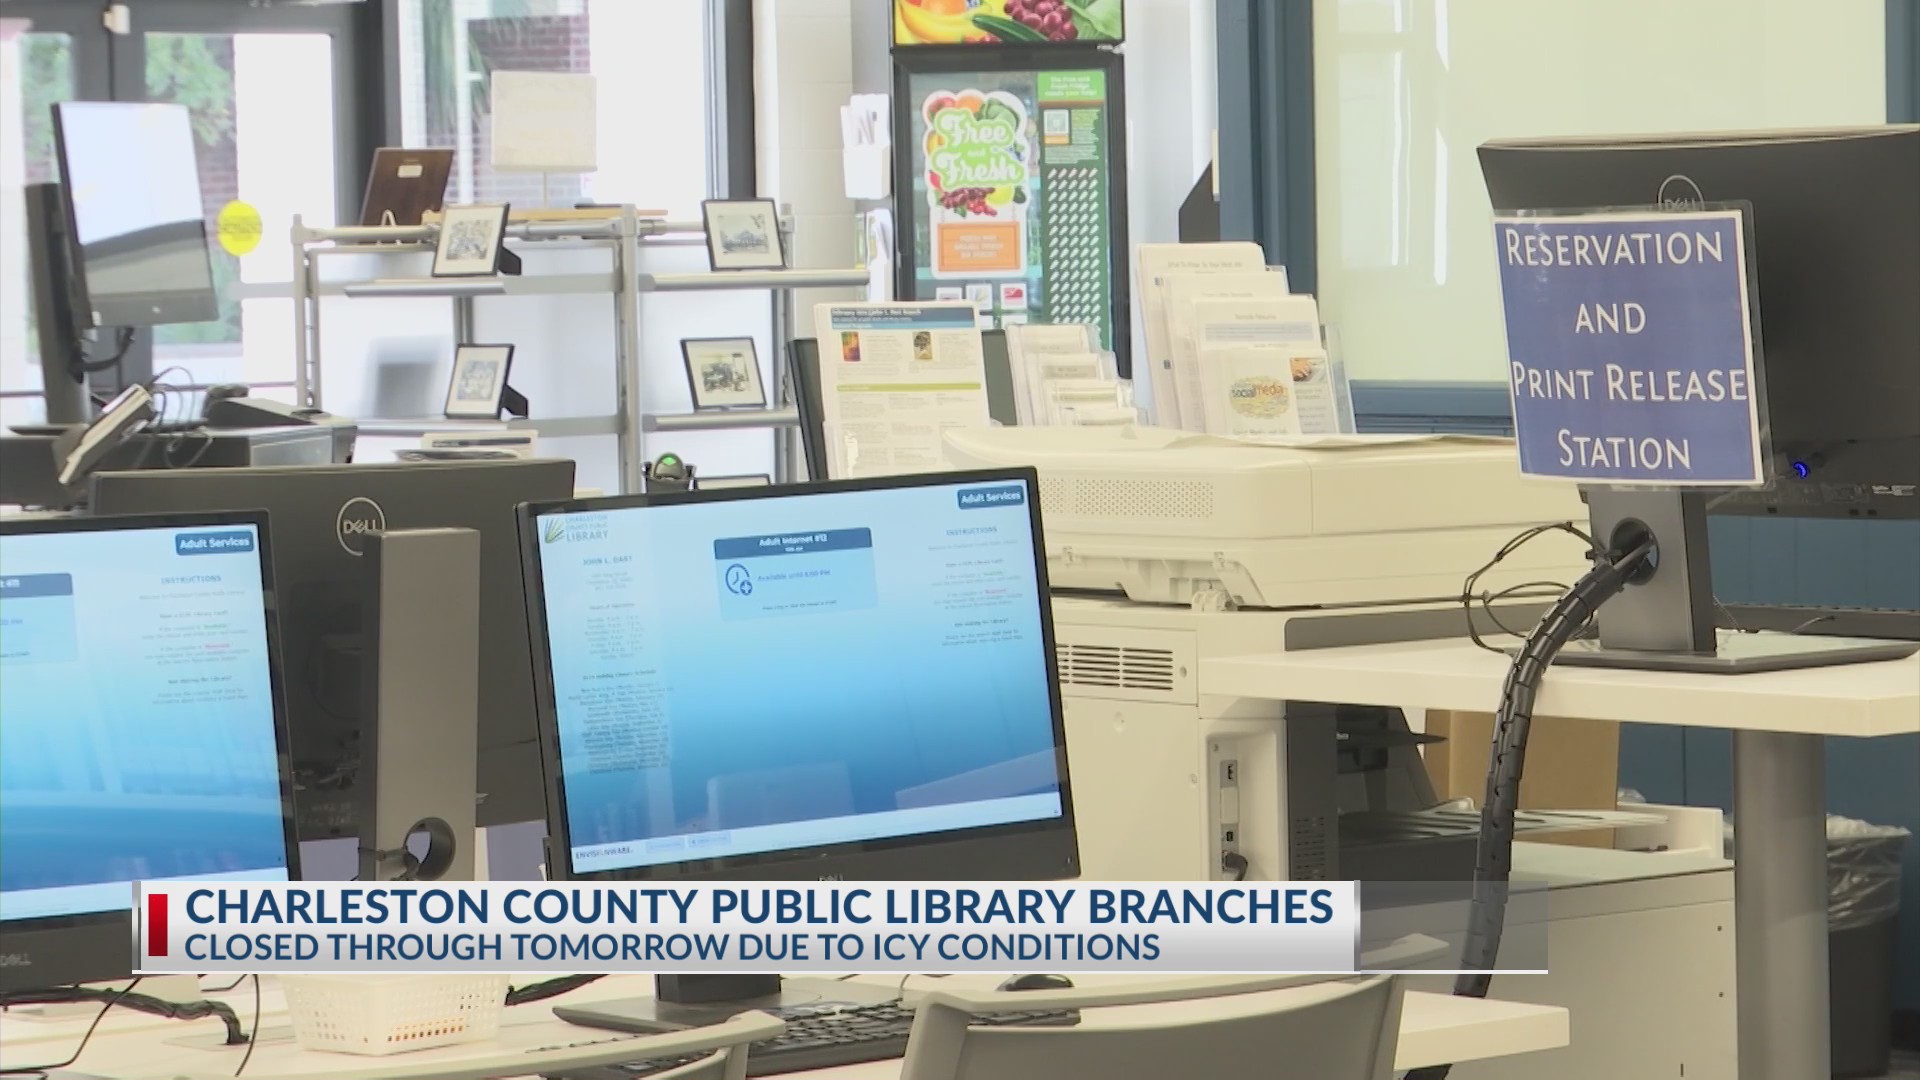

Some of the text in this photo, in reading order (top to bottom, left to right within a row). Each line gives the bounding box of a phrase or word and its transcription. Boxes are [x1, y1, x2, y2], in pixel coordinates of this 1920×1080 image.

[941, 114, 1006, 147] Free
[936, 151, 1018, 186] Fresh
[1505, 228, 1723, 267] RESERVATION
[1575, 303, 1647, 334] AND
[1512, 361, 1748, 401] PRINT RELEASE
[1557, 429, 1691, 470] STATION
[961, 491, 1021, 503] Adult Services
[180, 537, 250, 550] Adult Services
[566, 530, 609, 542] LIBRARY
[759, 537, 781, 546] Adult
[161, 575, 222, 585] INSTRUCTIONS
